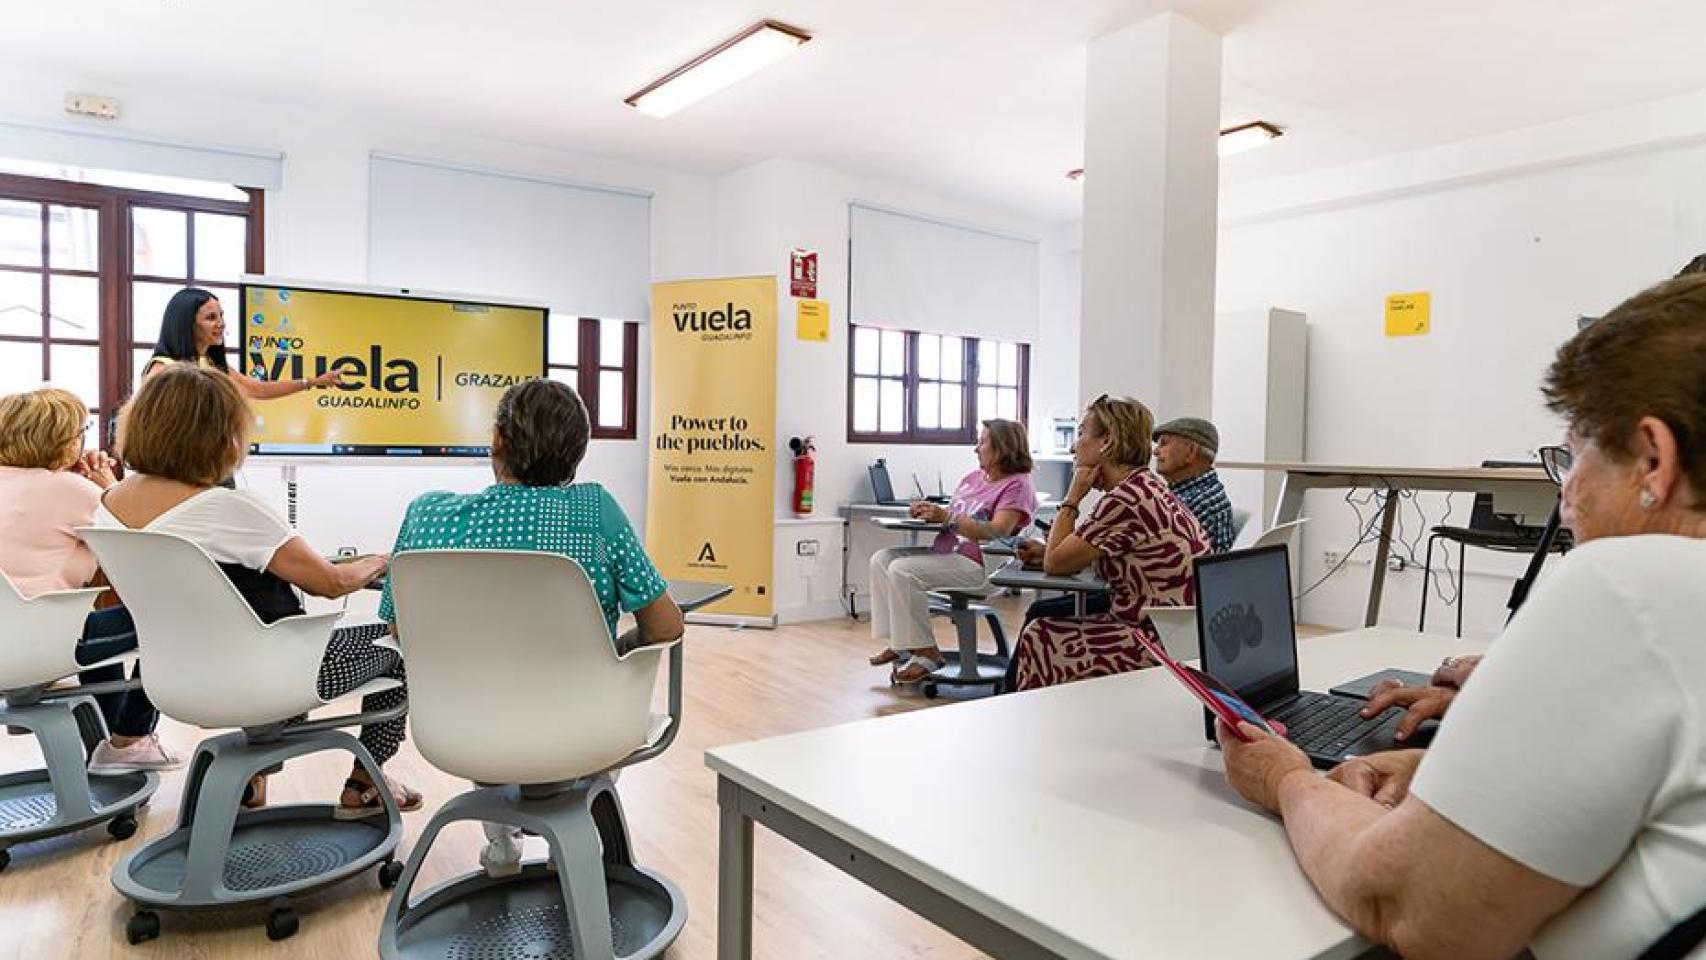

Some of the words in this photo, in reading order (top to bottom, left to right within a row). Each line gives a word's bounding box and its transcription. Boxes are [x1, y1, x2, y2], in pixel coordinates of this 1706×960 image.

[673, 302, 751, 332] vuela
[317, 396, 421, 411] GUADALINFO
[671, 414, 727, 431] Power
[729, 415, 748, 431] to
[656, 432, 683, 451] the
[687, 432, 766, 455] pueblos.
